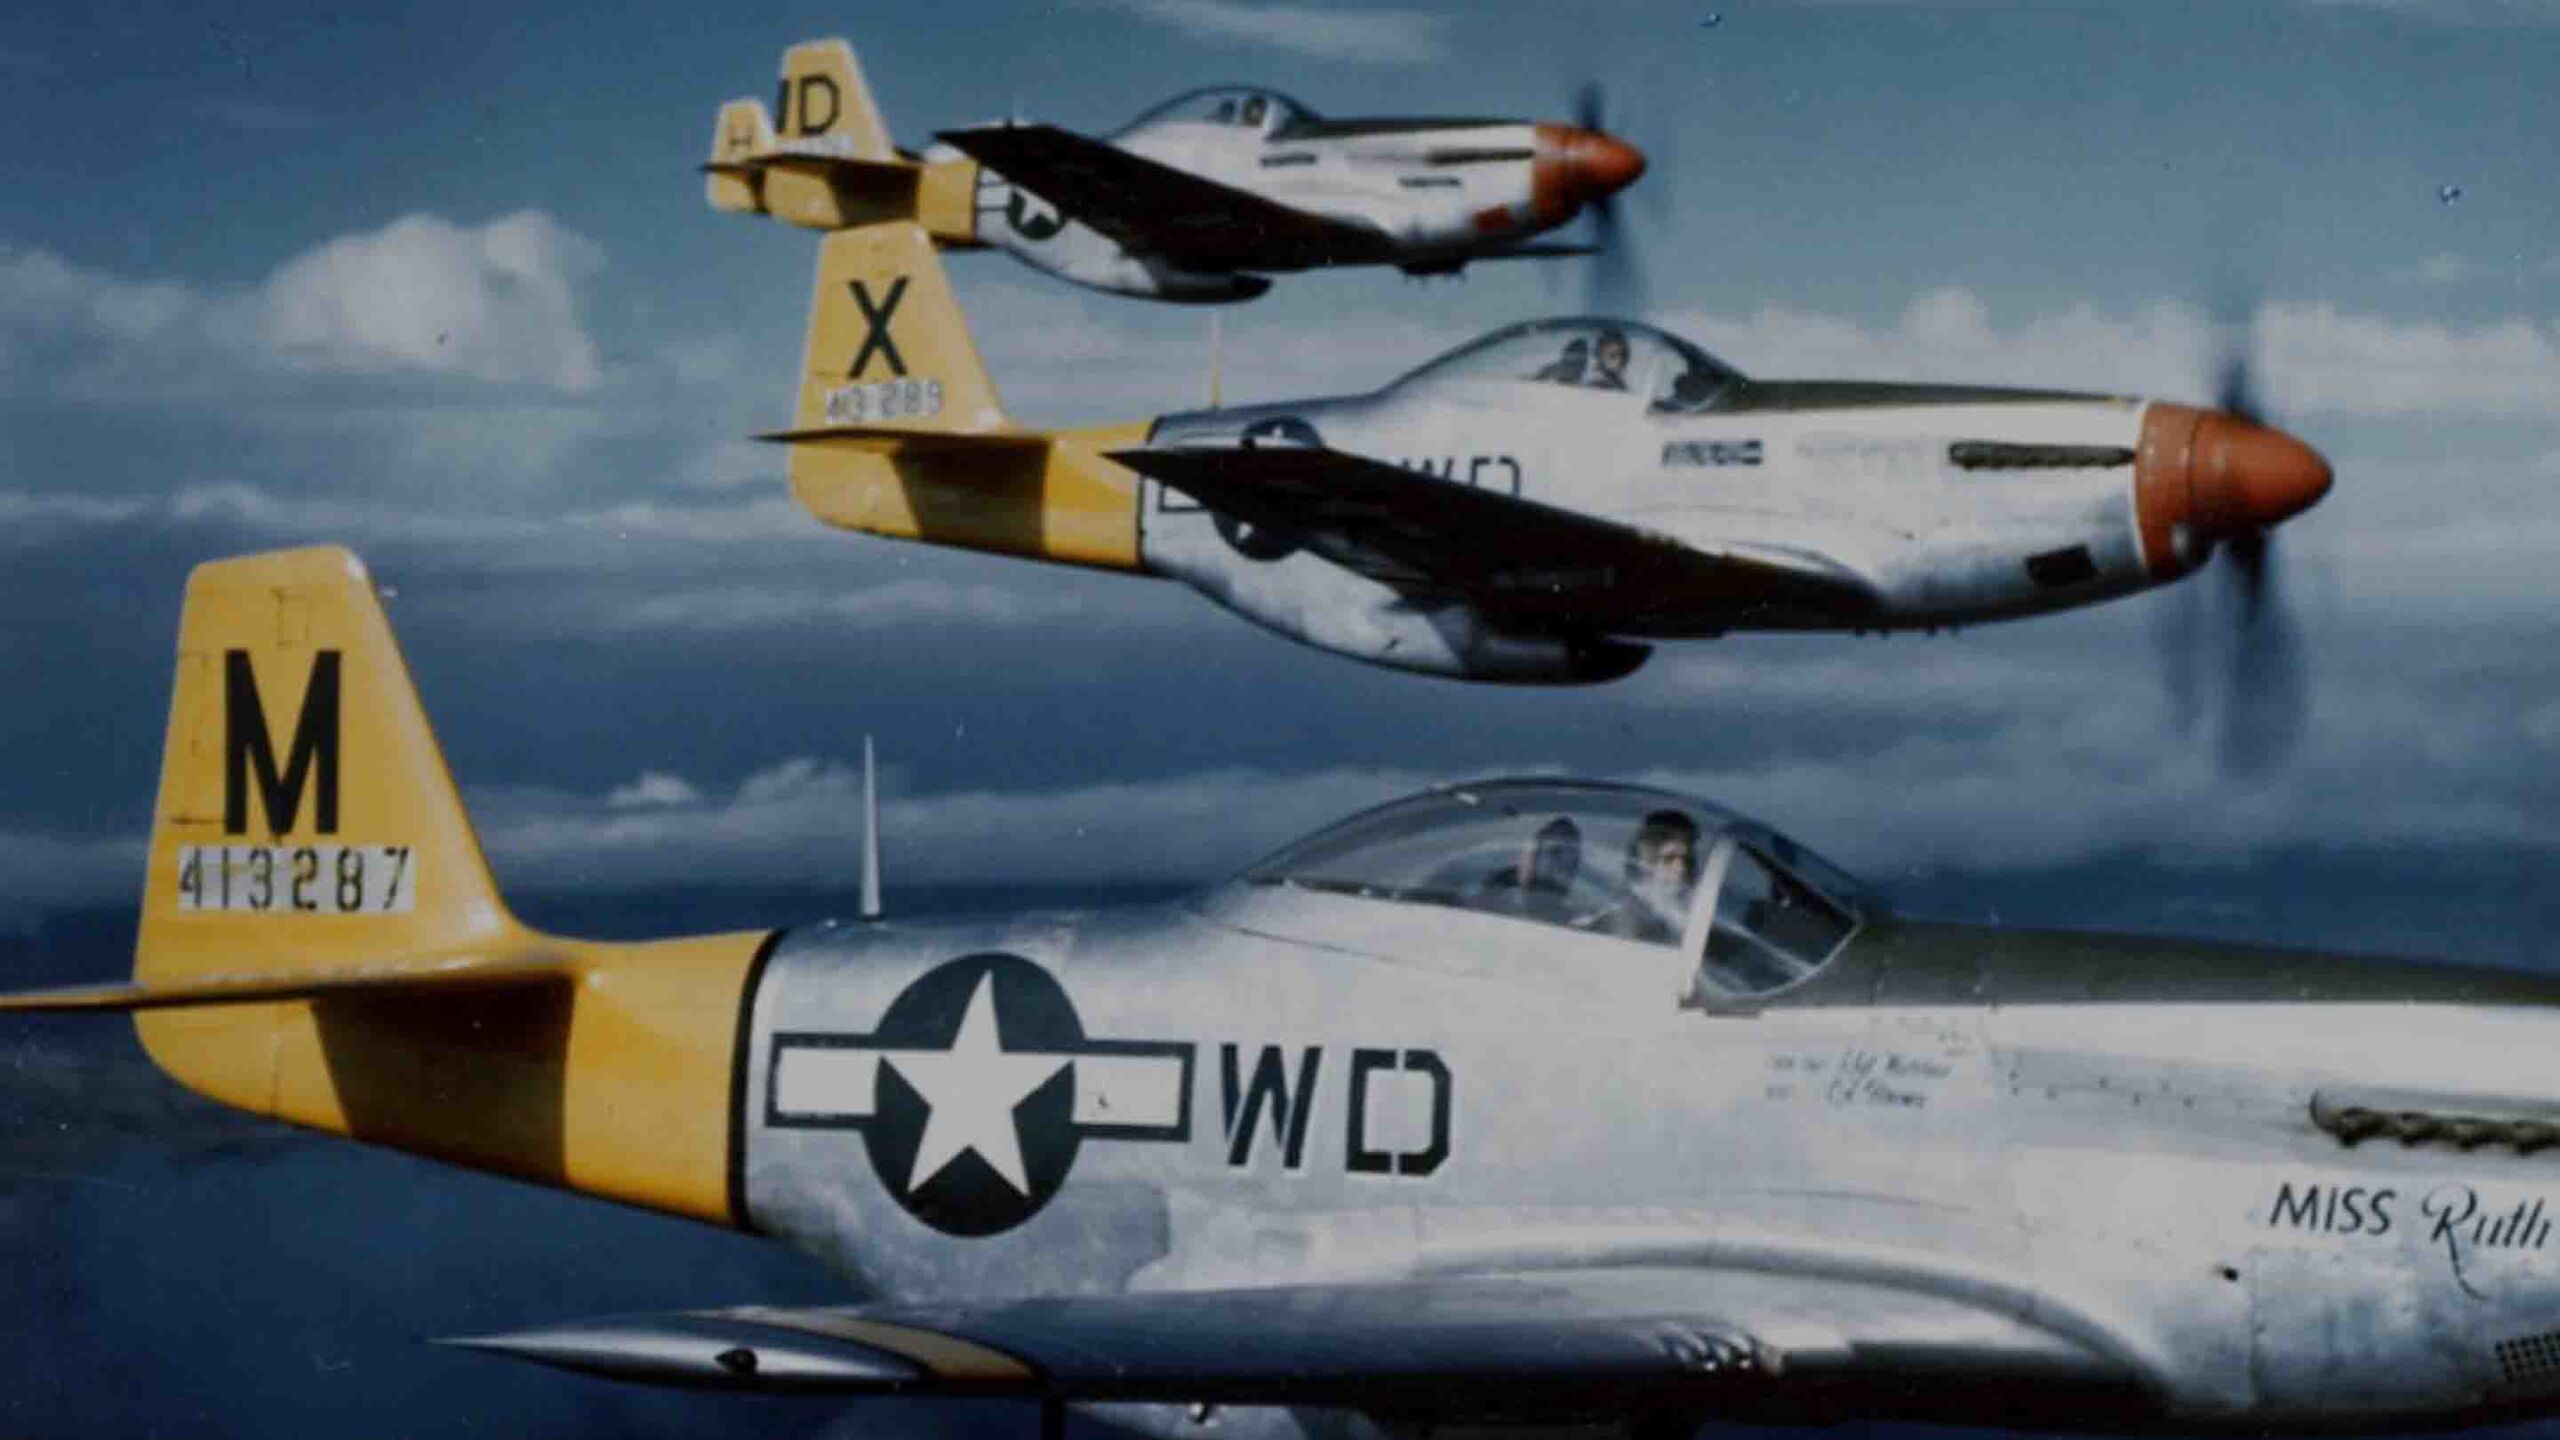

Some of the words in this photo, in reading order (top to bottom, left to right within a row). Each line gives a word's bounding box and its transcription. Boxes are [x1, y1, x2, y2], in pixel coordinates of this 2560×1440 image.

[847, 274, 910, 379] X
[223, 648, 341, 836] M
[179, 846, 410, 912] 413287
[2269, 1183, 2396, 1236] MISS
[2421, 1183, 2552, 1300] Ruth
